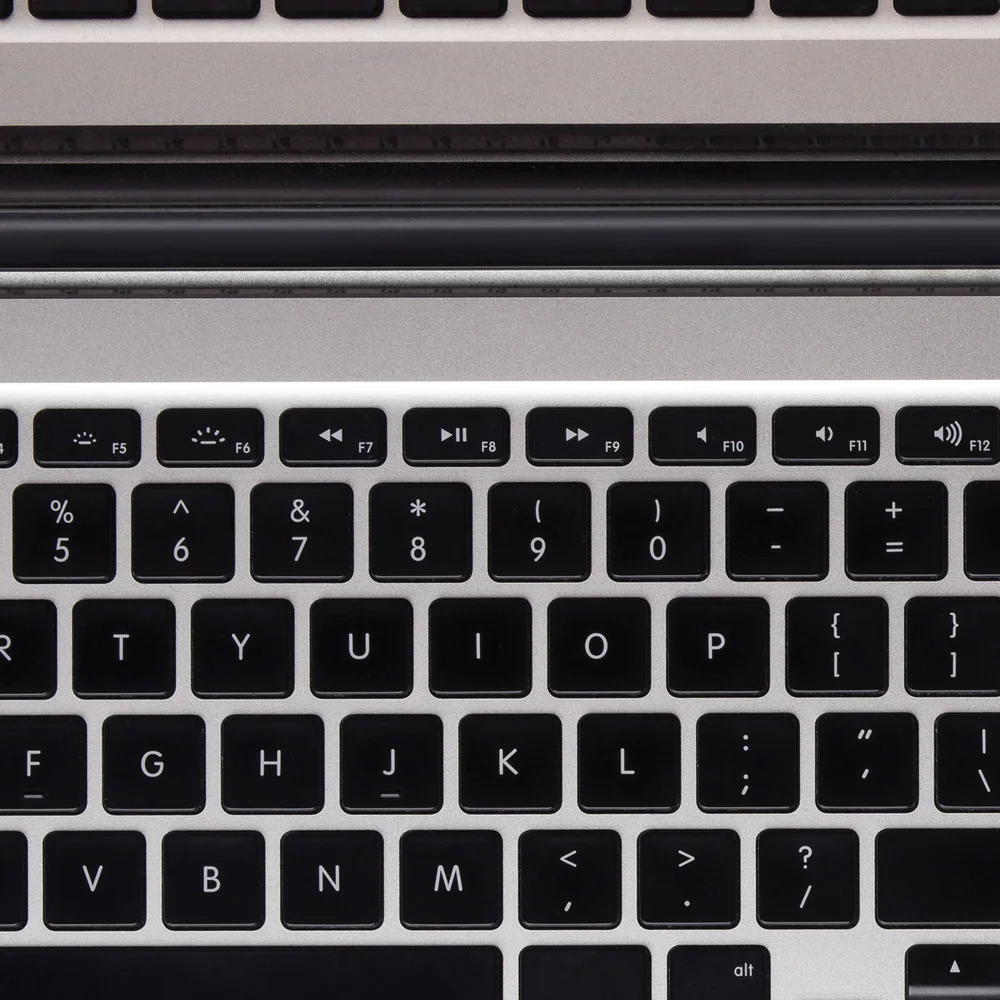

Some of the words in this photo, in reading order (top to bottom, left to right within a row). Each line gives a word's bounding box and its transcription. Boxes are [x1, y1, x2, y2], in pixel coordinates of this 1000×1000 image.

[112, 442, 127, 455] F5
[235, 442, 251, 454] F6
[358, 441, 374, 454] F7
[481, 440, 497, 453] F8
[605, 440, 620, 453] F9
[723, 440, 745, 453] F10
[849, 439, 867, 452] F11
[969, 439, 991, 452] F12
[53, 537, 70, 563] 5
[173, 536, 190, 562] 6
[291, 536, 308, 562] 7
[410, 536, 427, 562] 8
[530, 536, 546, 562] 9
[649, 535, 667, 561] 0
[112, 633, 130, 661] T
[231, 633, 251, 661] Y
[348, 632, 370, 660] U
[475, 632, 481, 660] I
[584, 632, 609, 660] O
[707, 632, 726, 660] P
[26, 750, 42, 777] F
[140, 750, 164, 778] G
[259, 749, 282, 777] H
[382, 748, 396, 776] J
[498, 748, 519, 776] K
[620, 747, 636, 775] L
[82, 864, 104, 892] V
[203, 865, 221, 893] B
[318, 864, 340, 892] N
[433, 864, 463, 892] M
[733, 962, 754, 977] alt
